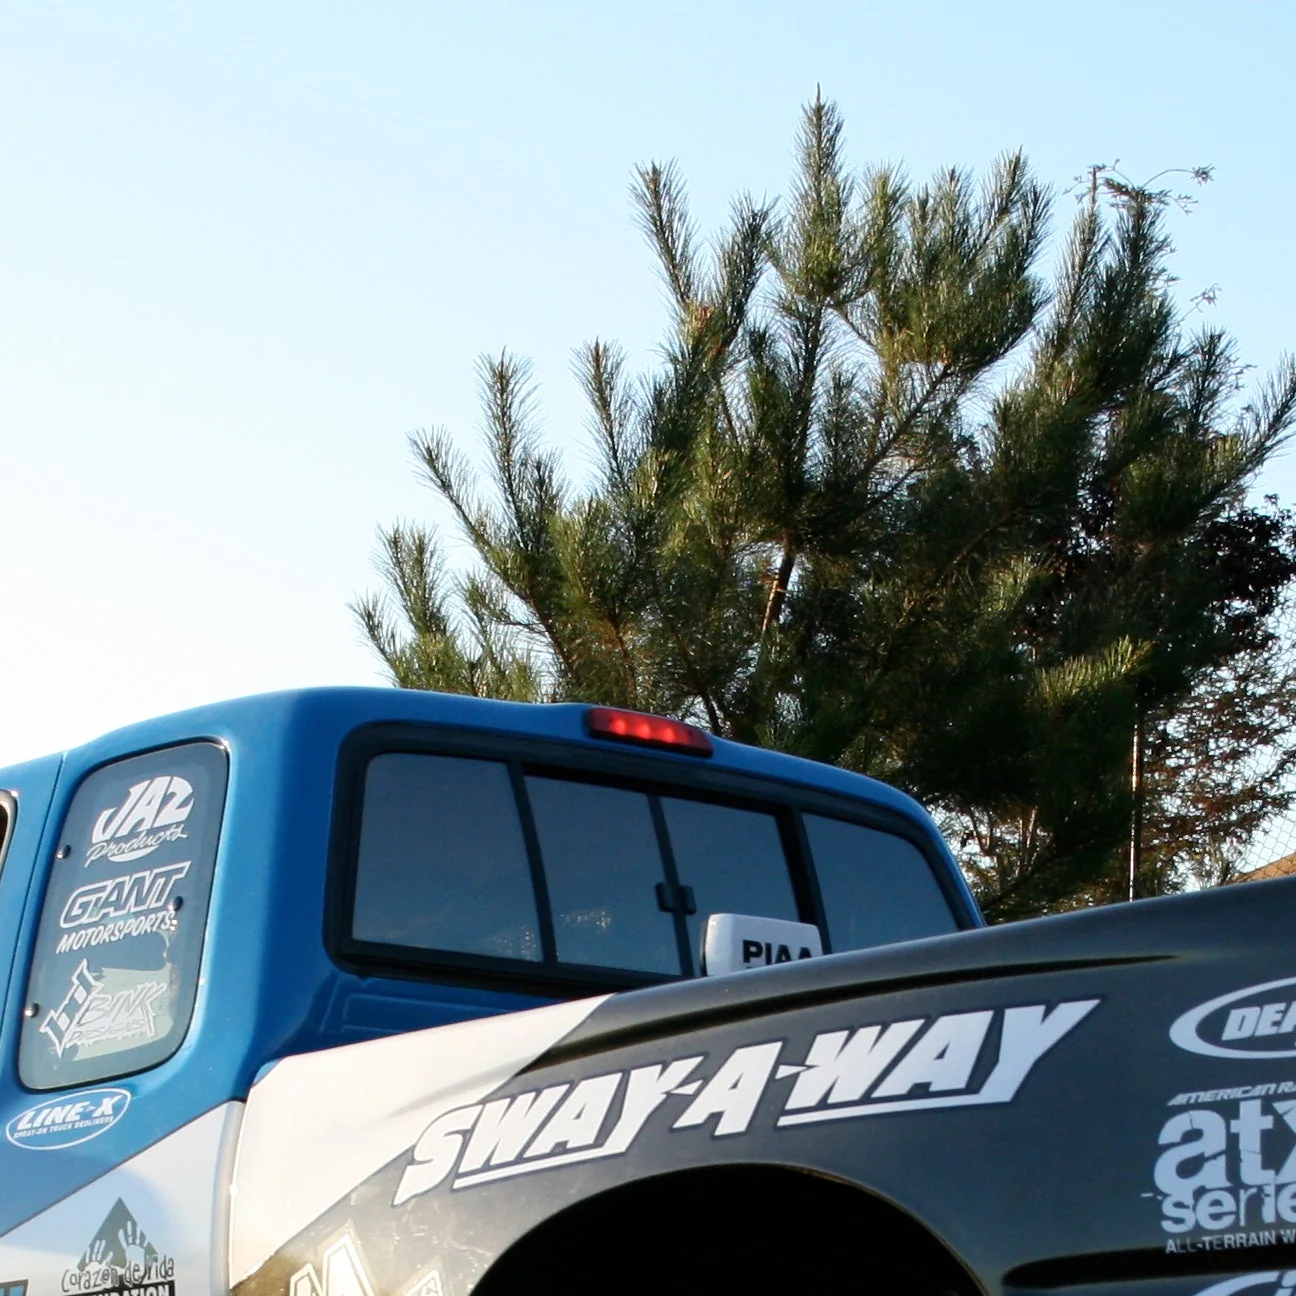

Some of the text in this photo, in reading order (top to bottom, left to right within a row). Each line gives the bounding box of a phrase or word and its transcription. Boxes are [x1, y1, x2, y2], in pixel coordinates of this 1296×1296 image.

[60, 860, 192, 928] GIANT
[55, 910, 176, 954] MOTORSPORTS
[16, 1094, 124, 1131] LINE-X
[1166, 1082, 1278, 1107] AMERICAN
